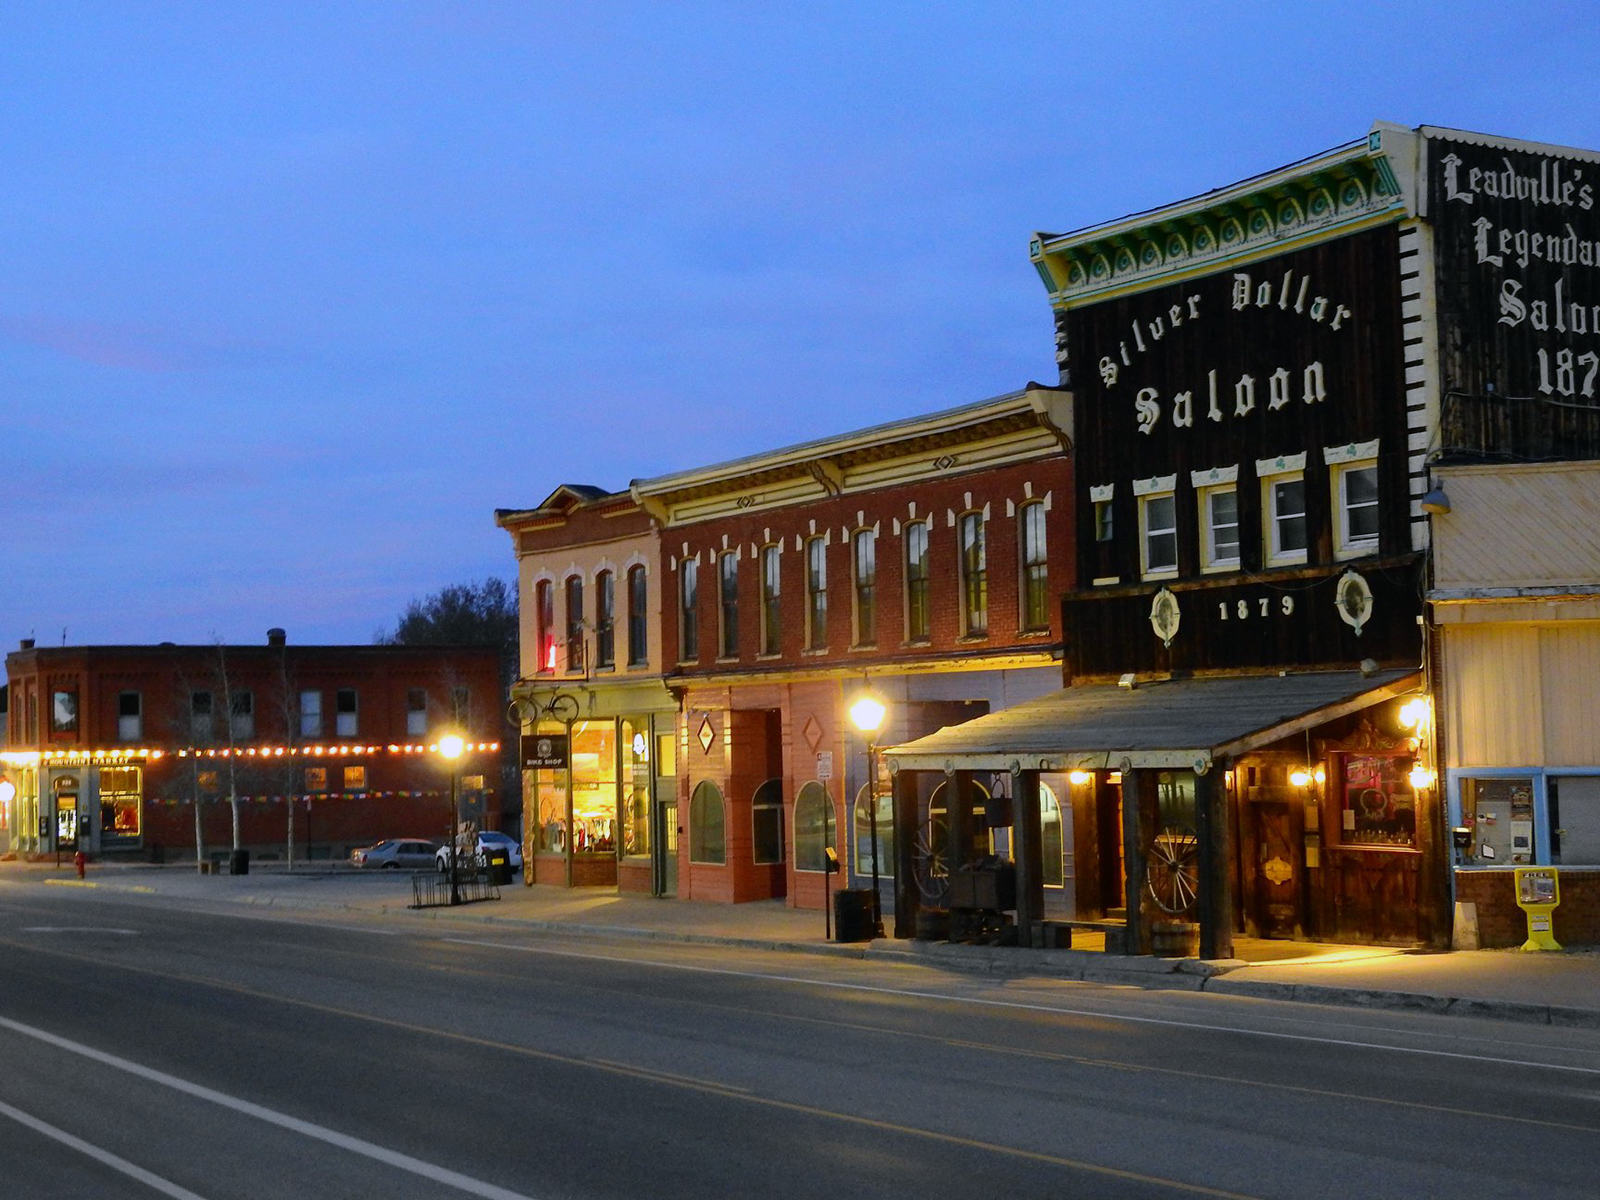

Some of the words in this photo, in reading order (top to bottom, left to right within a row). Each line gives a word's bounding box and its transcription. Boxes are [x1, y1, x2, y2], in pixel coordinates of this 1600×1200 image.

[1440, 153, 1594, 210] Leadville's
[1099, 294, 1200, 389] Silver
[1232, 269, 1351, 331] Dollar
[1135, 361, 1326, 435] Saloon
[1219, 595, 1294, 620] 1879
